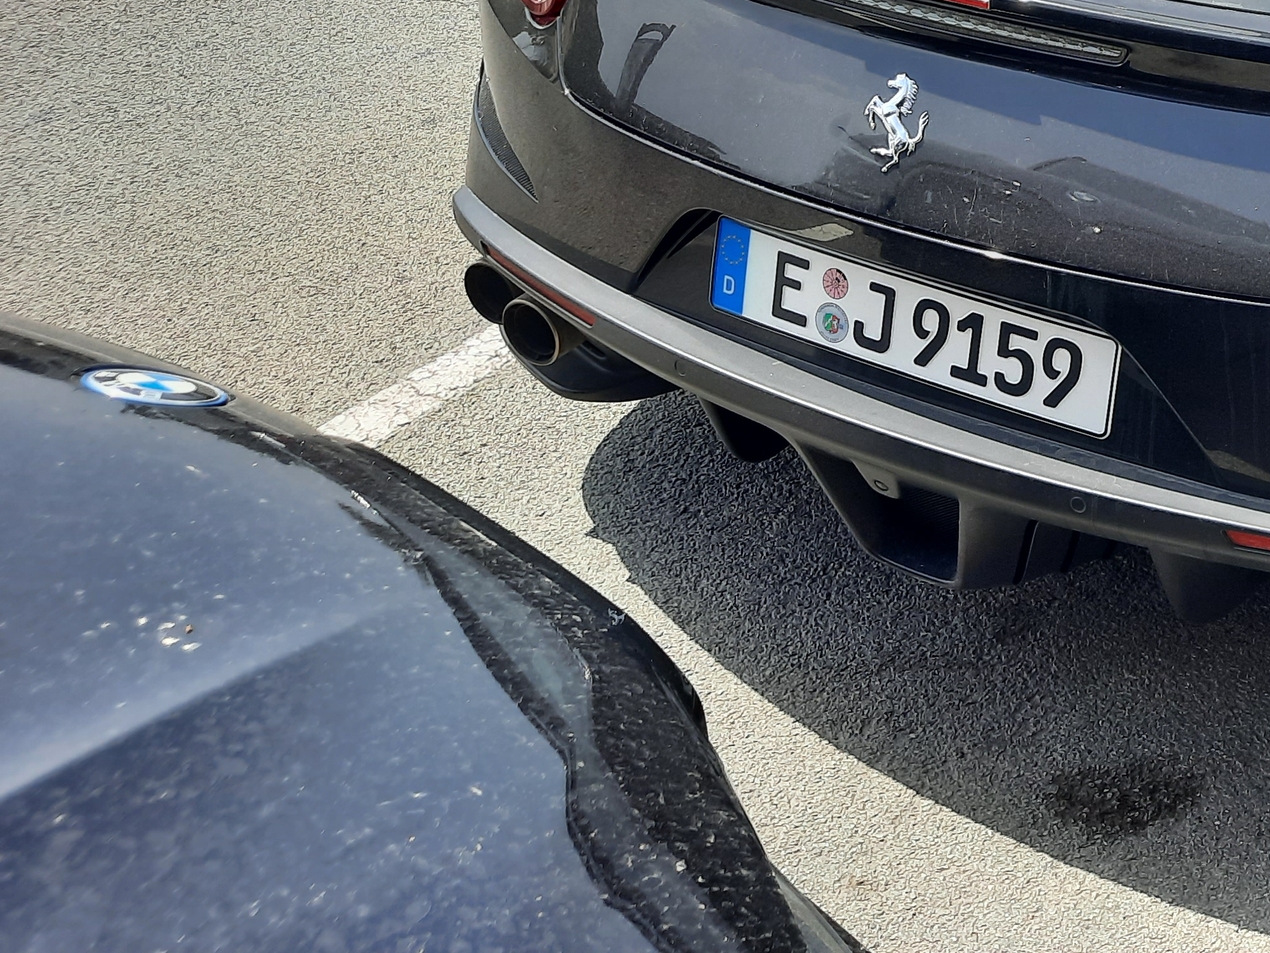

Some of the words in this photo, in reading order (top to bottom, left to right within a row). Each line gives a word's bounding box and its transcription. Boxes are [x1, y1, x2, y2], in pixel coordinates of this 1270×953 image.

[722, 274, 735, 295] D
[771, 250, 810, 328] E
[853, 281, 896, 354] J
[912, 298, 1083, 409] 9159
